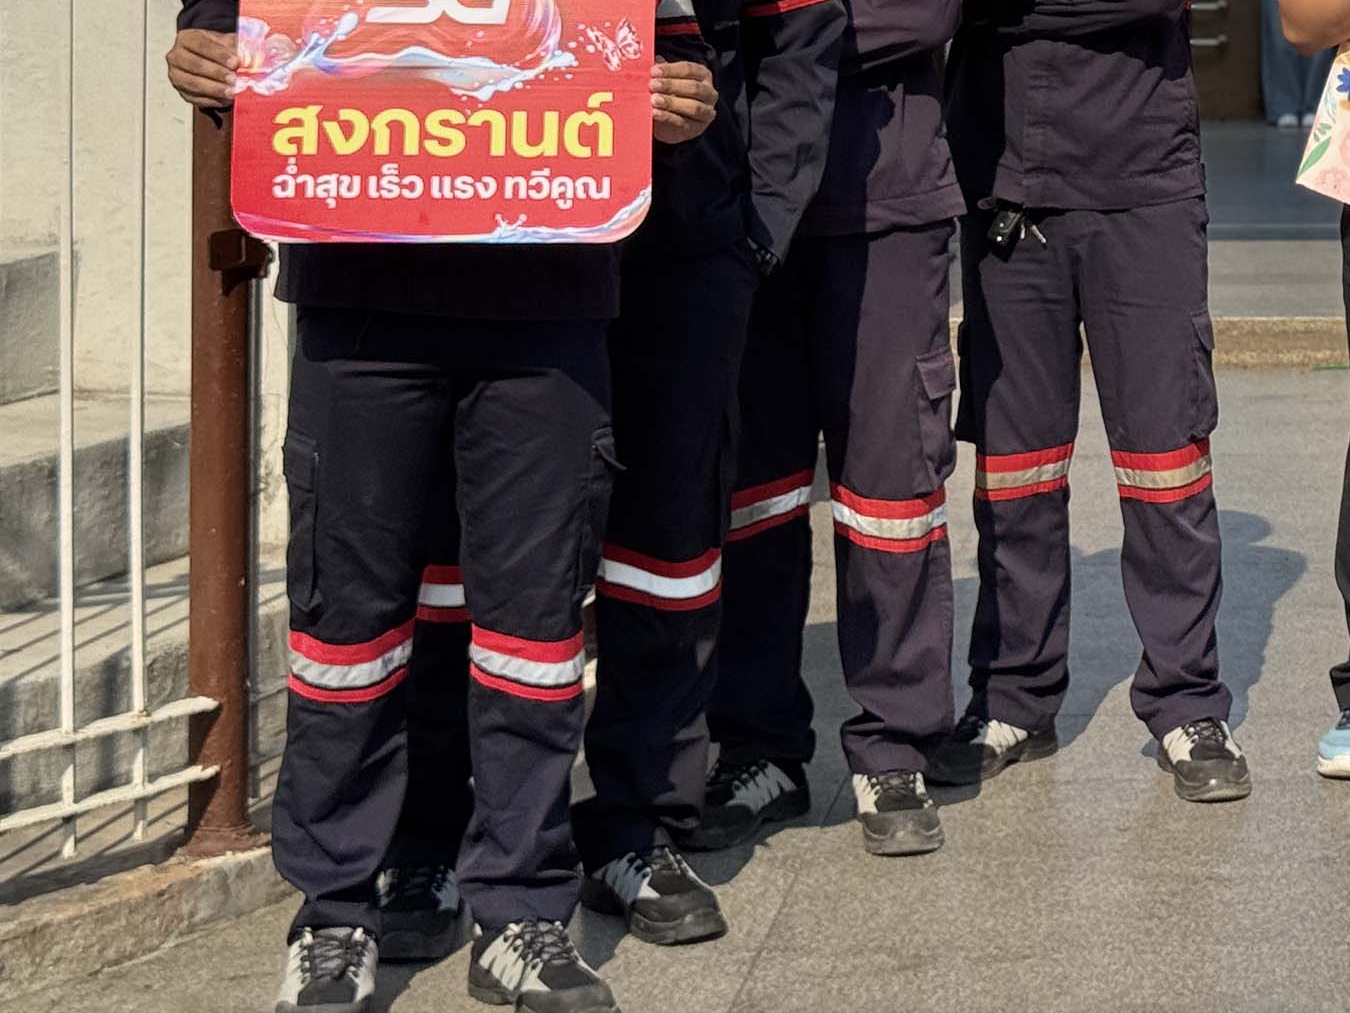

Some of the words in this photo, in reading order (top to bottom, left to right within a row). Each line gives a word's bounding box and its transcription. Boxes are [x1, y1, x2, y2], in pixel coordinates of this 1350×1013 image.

[271, 92, 615, 158] สงกรานต์
[272, 157, 361, 209] ฉ่ำสุข
[368, 163, 424, 200] เร็ว
[430, 174, 498, 200] แรง
[504, 168, 612, 210] ทวีคูณ
